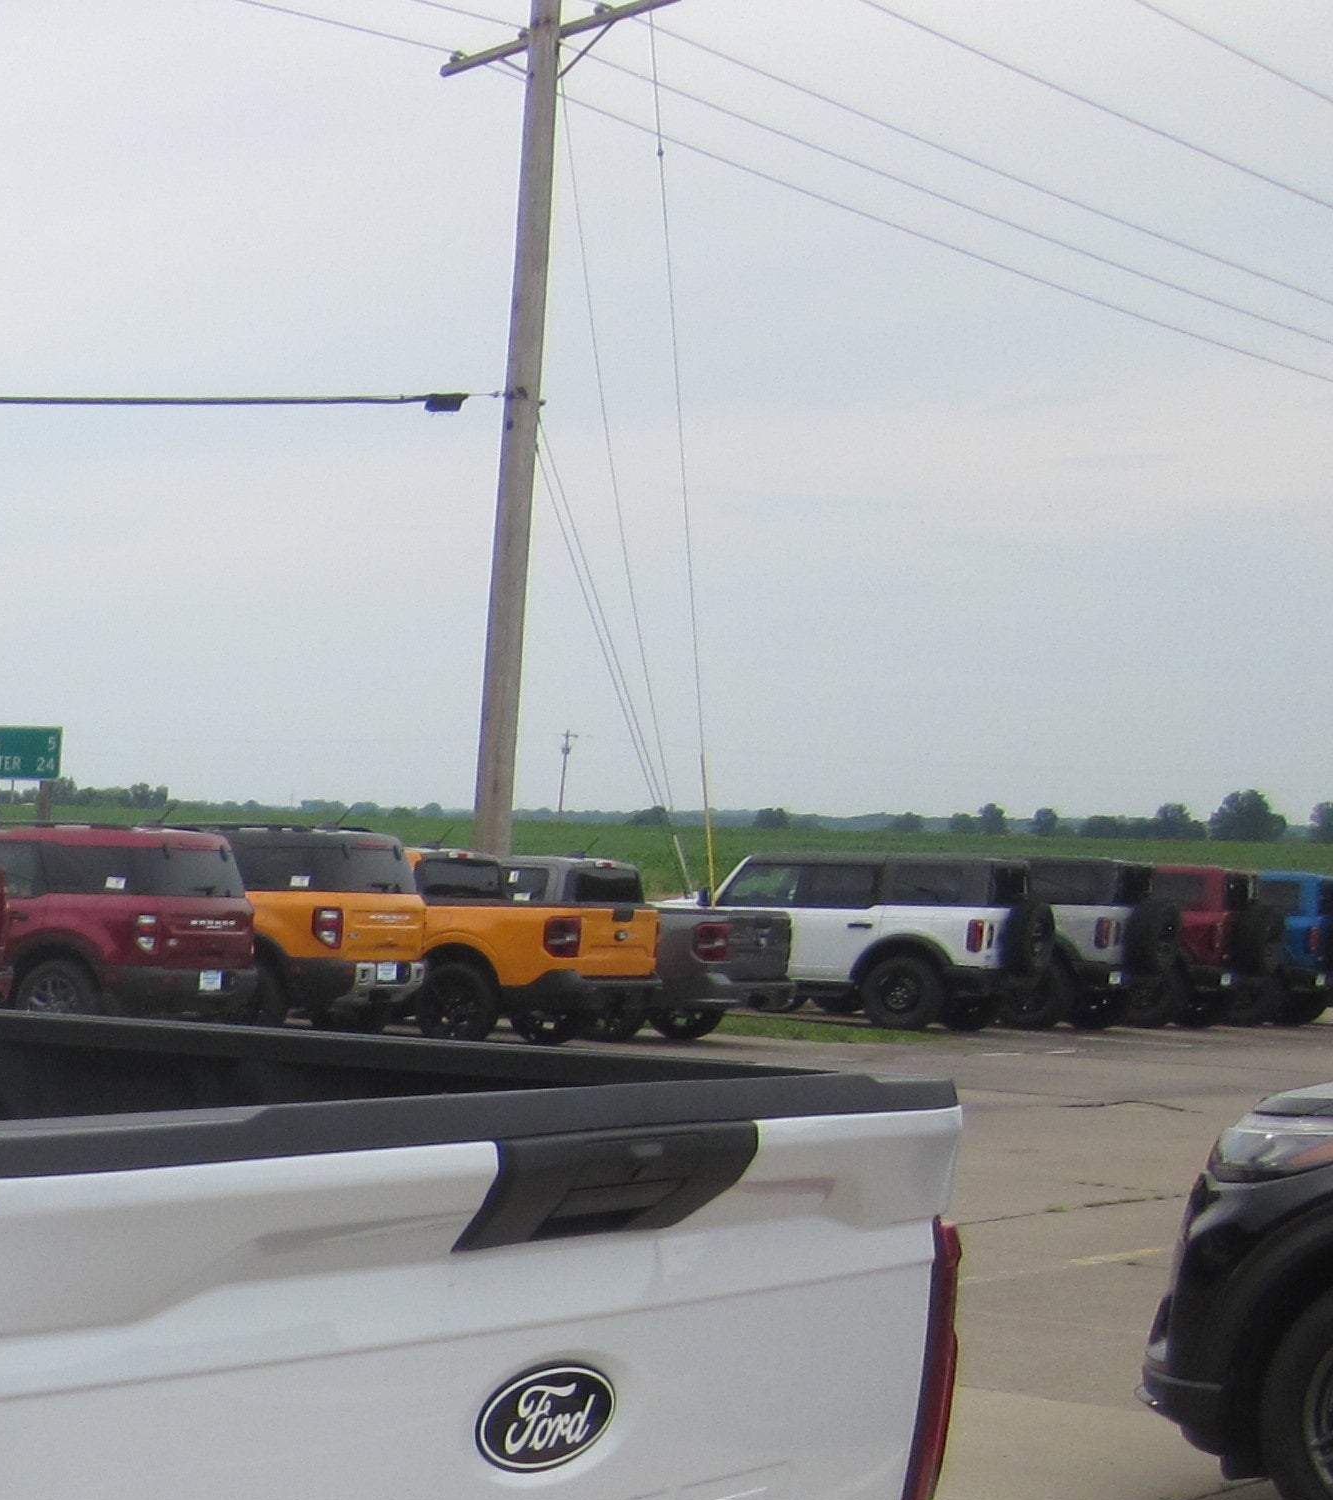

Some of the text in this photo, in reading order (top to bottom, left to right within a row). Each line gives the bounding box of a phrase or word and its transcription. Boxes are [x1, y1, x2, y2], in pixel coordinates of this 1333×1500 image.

[48, 736, 56, 751] 5
[36, 757, 55, 771] 24
[504, 1382, 597, 1455] Ford
